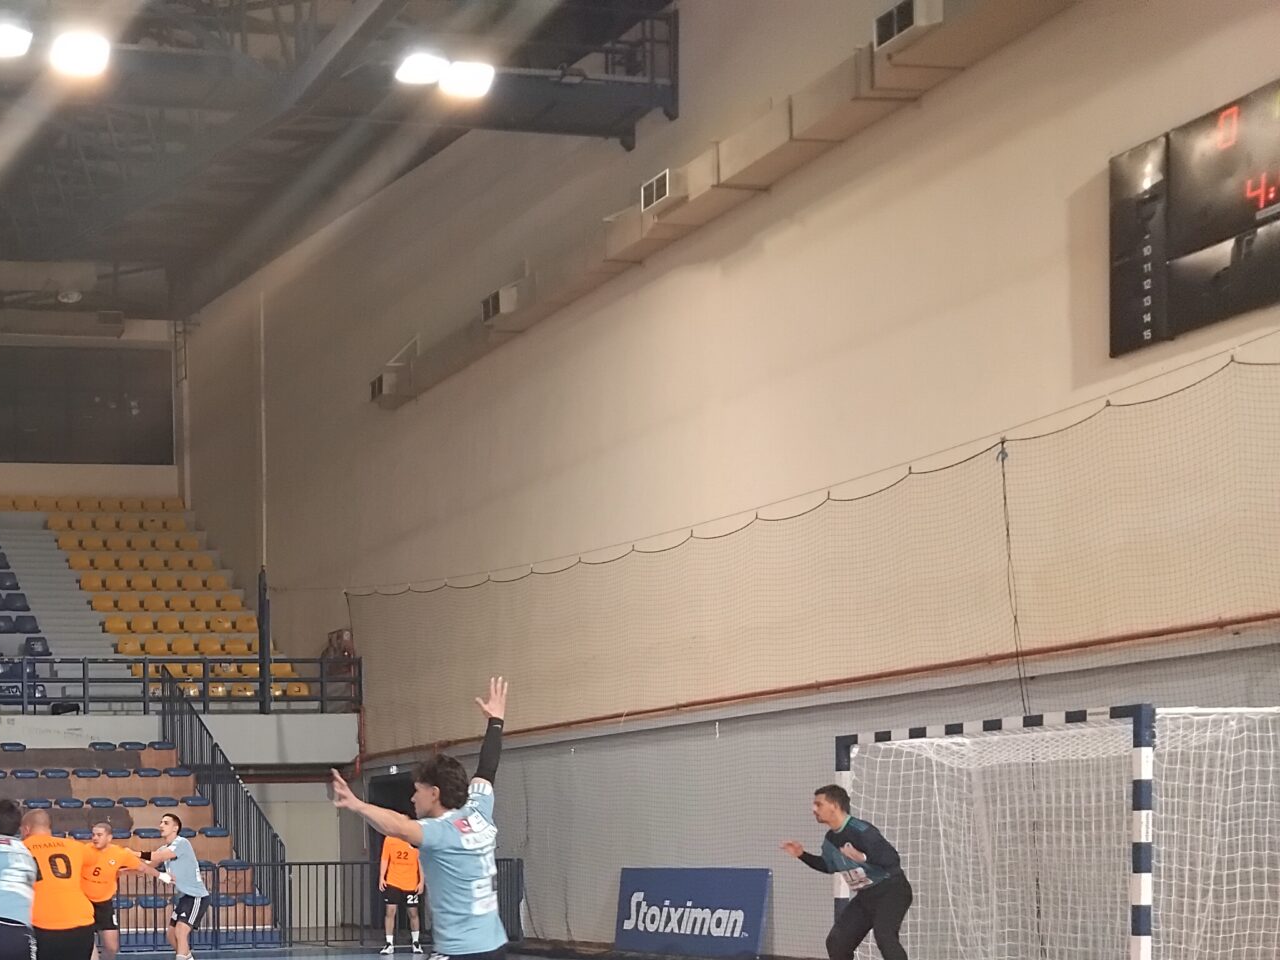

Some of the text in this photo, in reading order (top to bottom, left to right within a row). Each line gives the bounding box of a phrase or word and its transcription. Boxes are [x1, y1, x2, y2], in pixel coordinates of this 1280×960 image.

[1142, 245, 1152, 256] 10
[1143, 262, 1152, 273] 11
[1143, 278, 1152, 290] 12
[1143, 295, 1152, 307] 13
[1142, 312, 1152, 323] 14
[1142, 328, 1152, 340] 15
[396, 850, 409, 860] 22
[92, 866, 101, 877] 6
[406, 894, 419, 904] 22
[623, 892, 744, 937] Stoiximan
